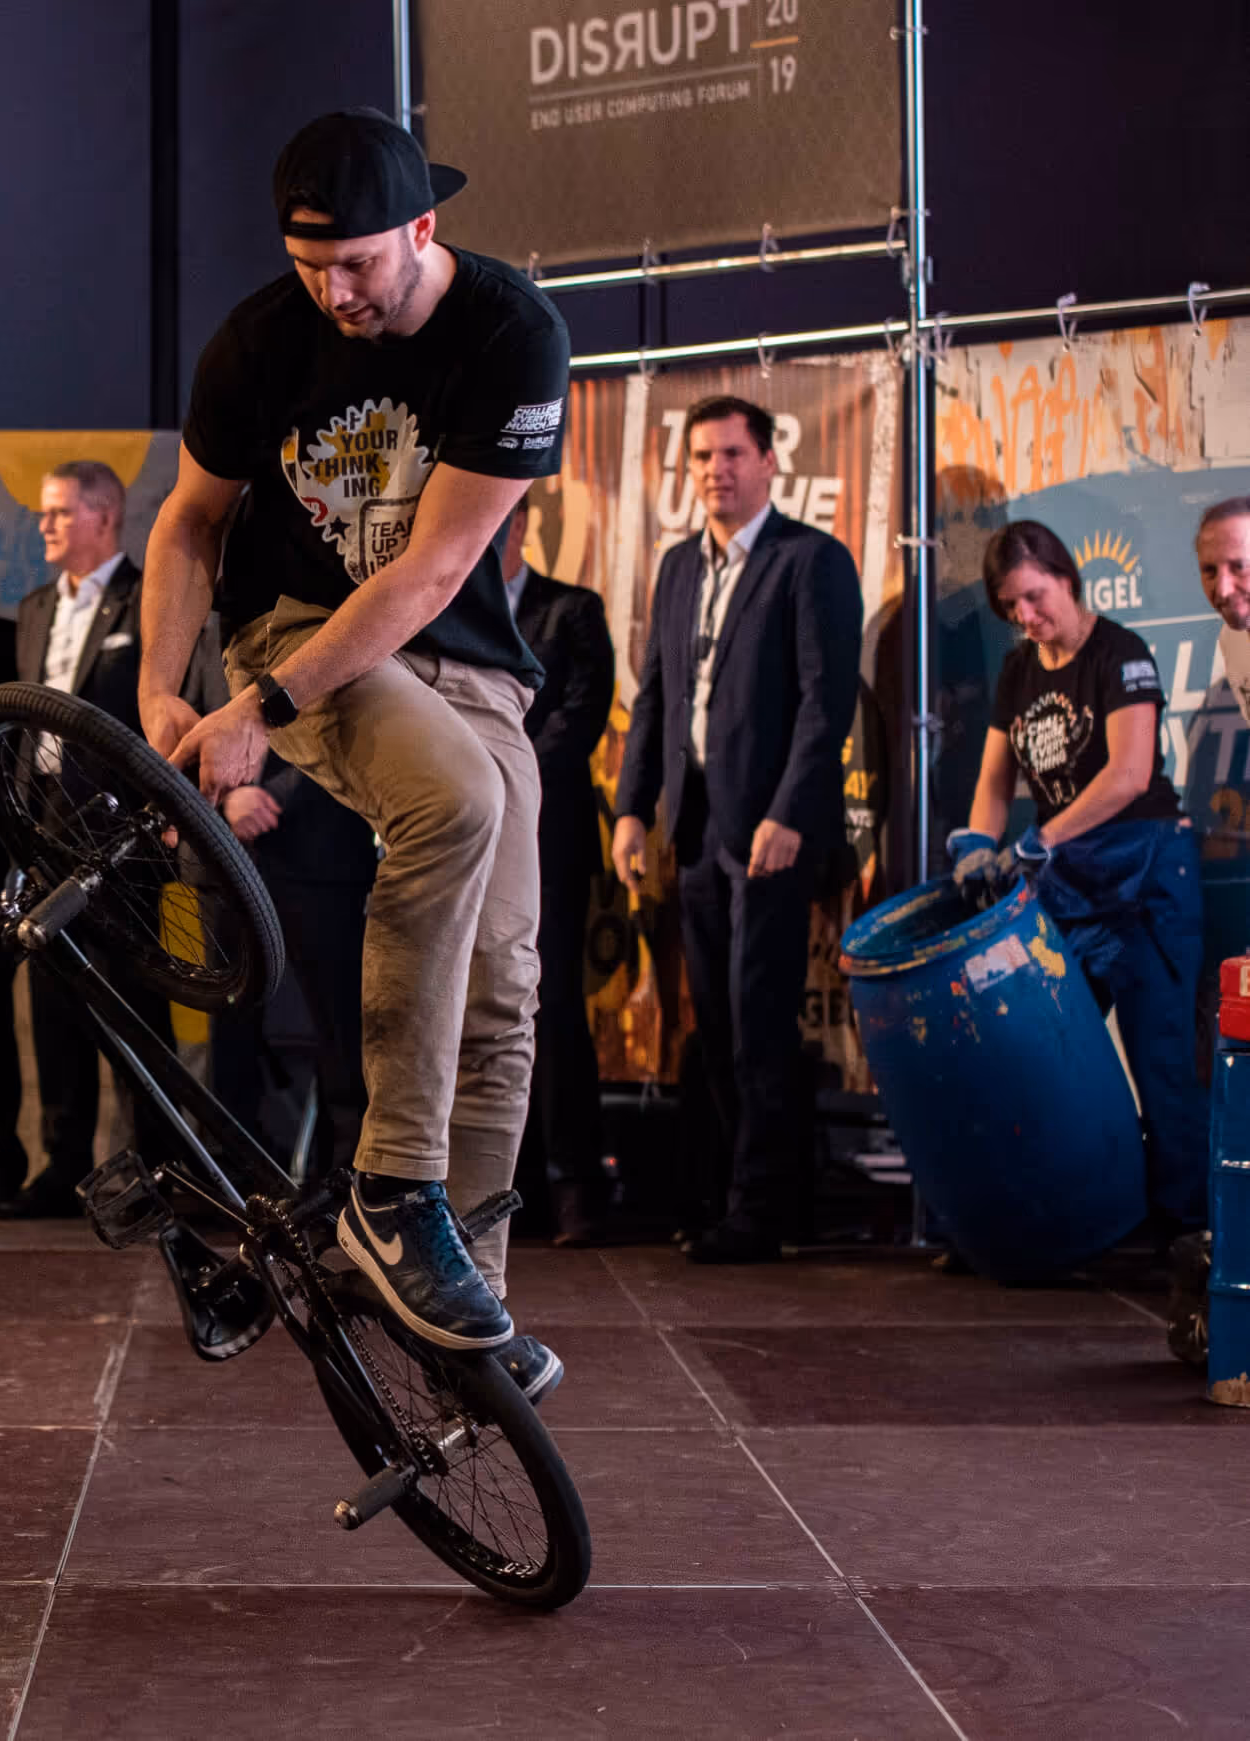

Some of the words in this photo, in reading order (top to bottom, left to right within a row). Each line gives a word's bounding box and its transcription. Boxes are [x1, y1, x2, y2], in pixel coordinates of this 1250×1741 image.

[770, 54, 797, 93] 19
[531, 107, 561, 131] END
[565, 101, 602, 125] USER
[607, 88, 693, 118] COMPUTING
[697, 80, 750, 104] FORUM
[342, 429, 399, 454] YOUR
[314, 453, 389, 479] THINK-
[343, 477, 381, 498] ING
[372, 537, 399, 555] UP
[1085, 575, 1143, 611] IGEL
